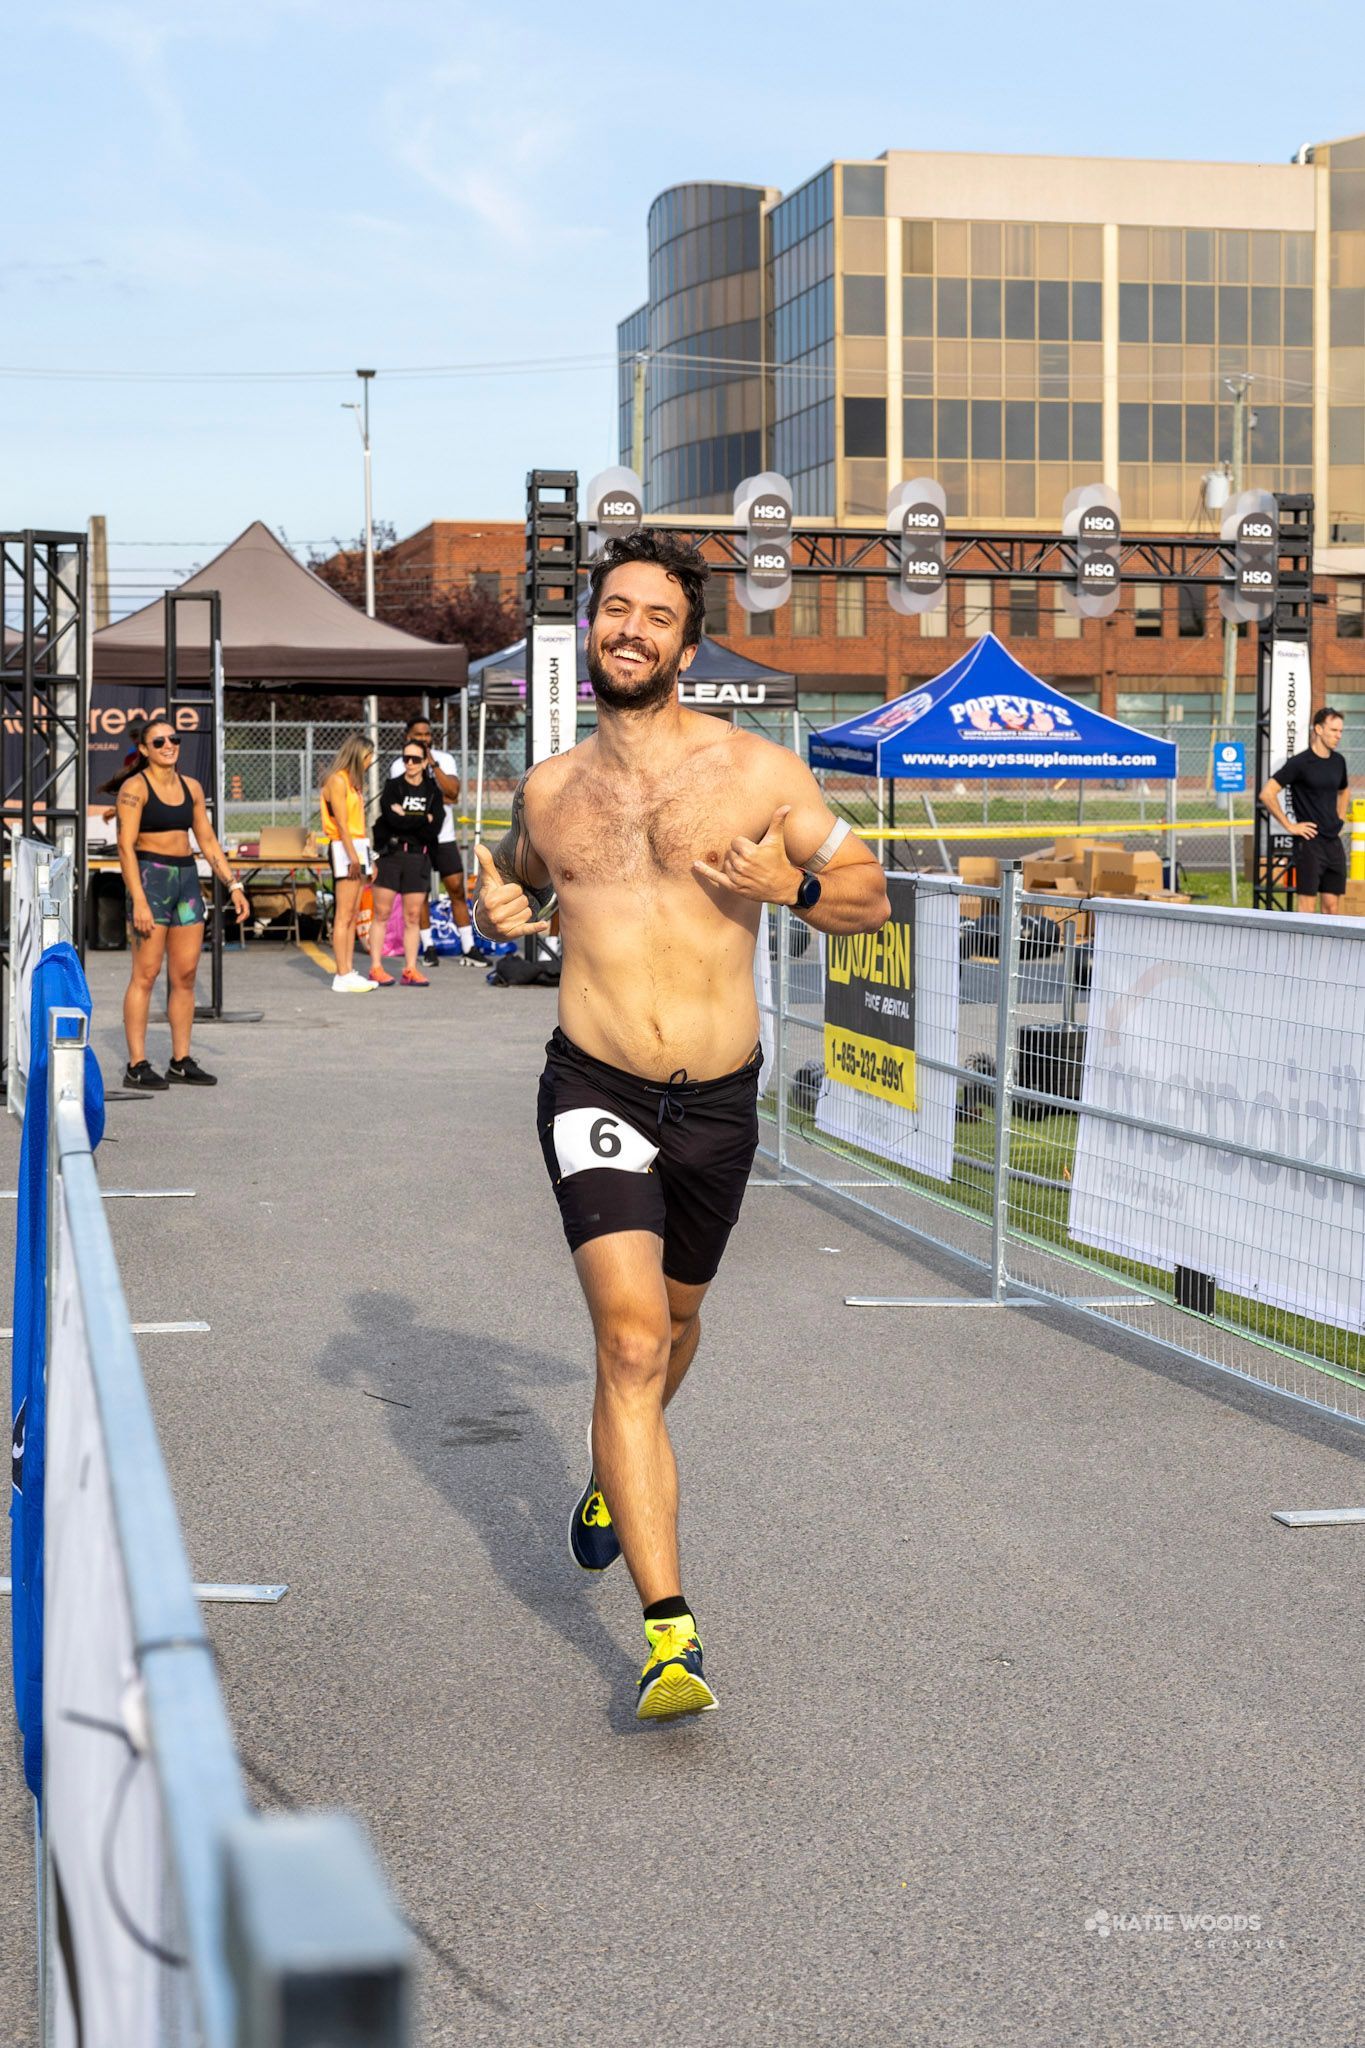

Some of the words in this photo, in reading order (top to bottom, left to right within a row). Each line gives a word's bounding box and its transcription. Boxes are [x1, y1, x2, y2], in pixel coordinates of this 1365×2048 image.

[603, 502, 636, 516] HSQ
[754, 505, 786, 519] HSQ
[908, 513, 939, 527] HSQ
[1084, 517, 1114, 531] HSQ
[1243, 523, 1273, 537] HSQ
[754, 555, 785, 569] HSQ
[908, 562, 940, 576] HSQ
[1084, 564, 1114, 577] HSQ
[1243, 571, 1273, 584] HSQ
[549, 657, 560, 704] HYROX
[677, 683, 766, 704] LEAU
[1286, 672, 1297, 716] HYROX
[948, 694, 1073, 726] POPEYE'S
[902, 751, 1156, 769] www.popeyessupplements.com
[1274, 836, 1294, 848] HS
[881, 997, 910, 1020] RENTAL
[589, 1117, 622, 1158] 6
